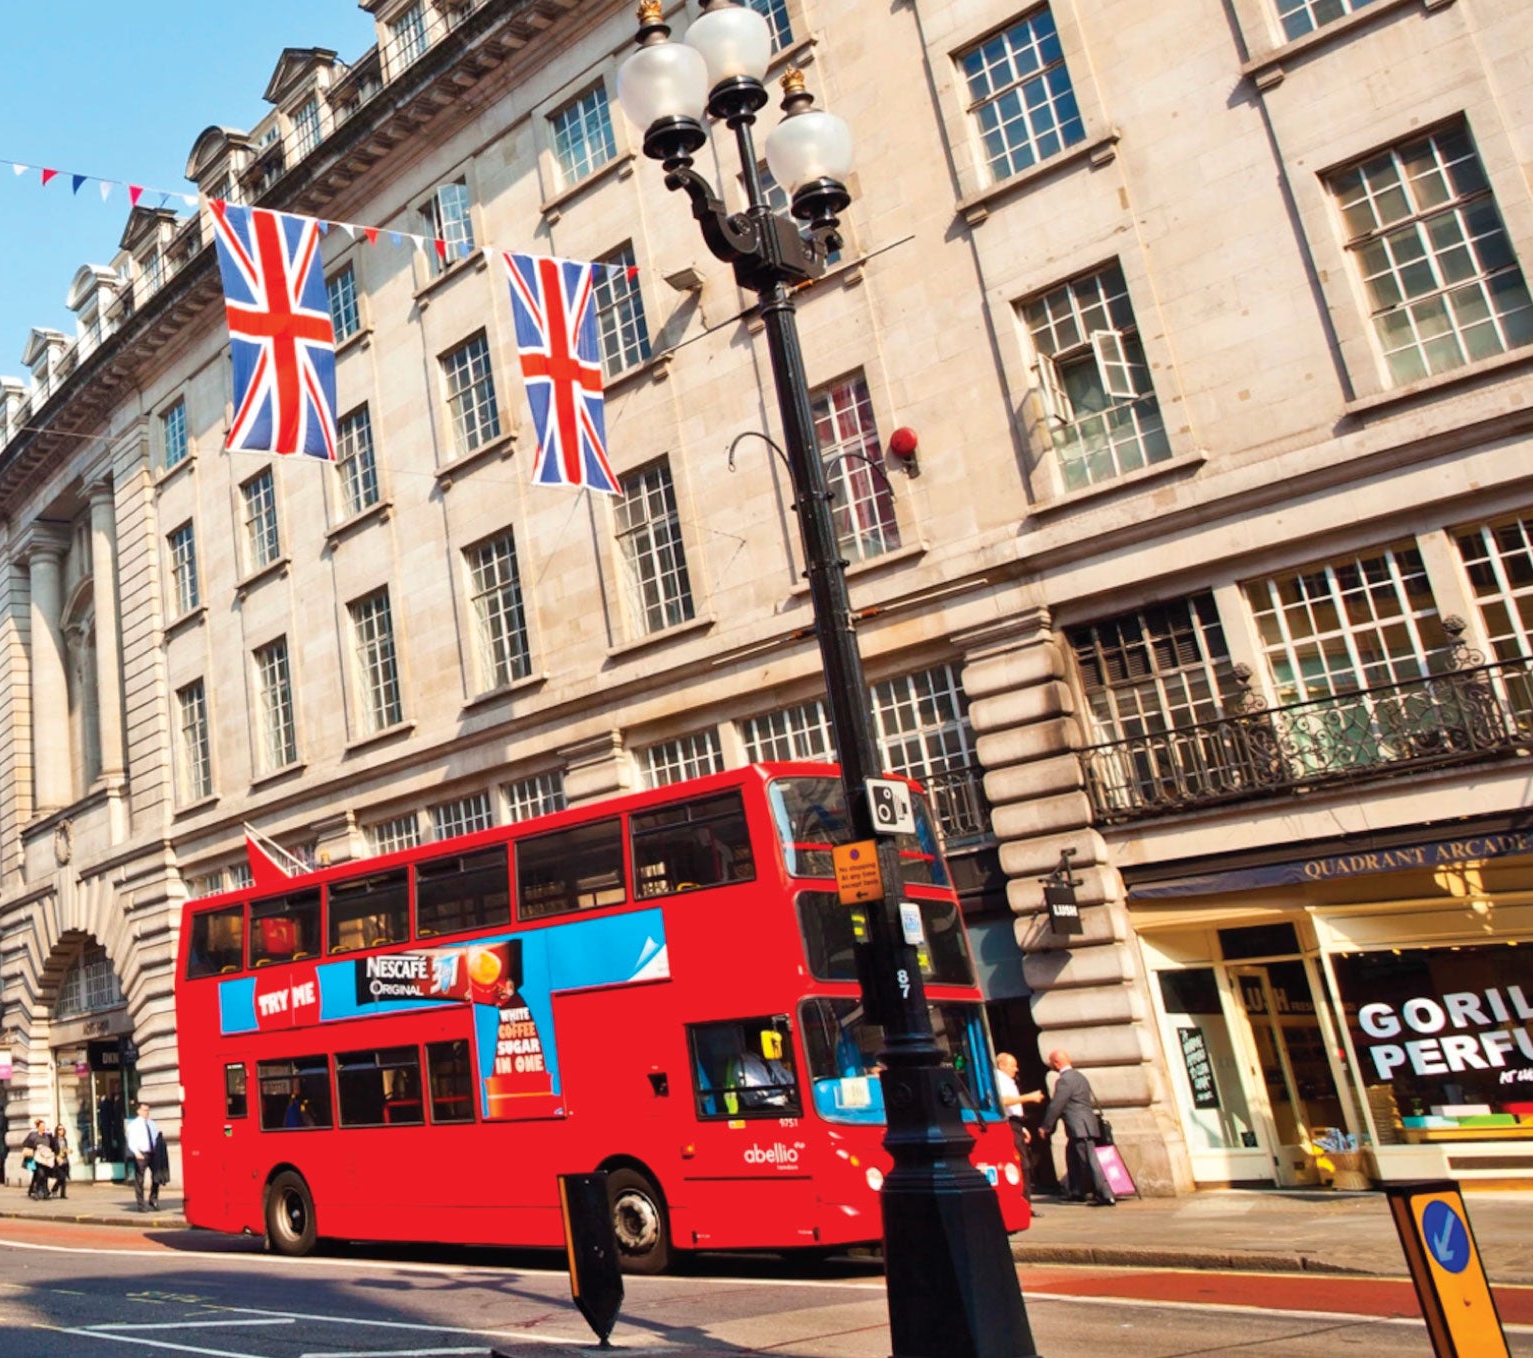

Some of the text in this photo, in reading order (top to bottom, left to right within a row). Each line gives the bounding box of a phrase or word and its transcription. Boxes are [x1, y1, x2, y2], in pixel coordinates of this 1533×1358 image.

[1304, 834, 1531, 879] QUADRANT ARCADE
[1053, 904, 1078, 917] LUSH
[366, 955, 429, 979] NESCAFÉ
[258, 981, 316, 1017] TRY ME
[499, 1007, 531, 1023] WHITE
[498, 1021, 537, 1040] COFFEE
[497, 1038, 542, 1056] SUGAR
[495, 1055, 545, 1074] IN ONE
[744, 1142, 798, 1163] abellio
